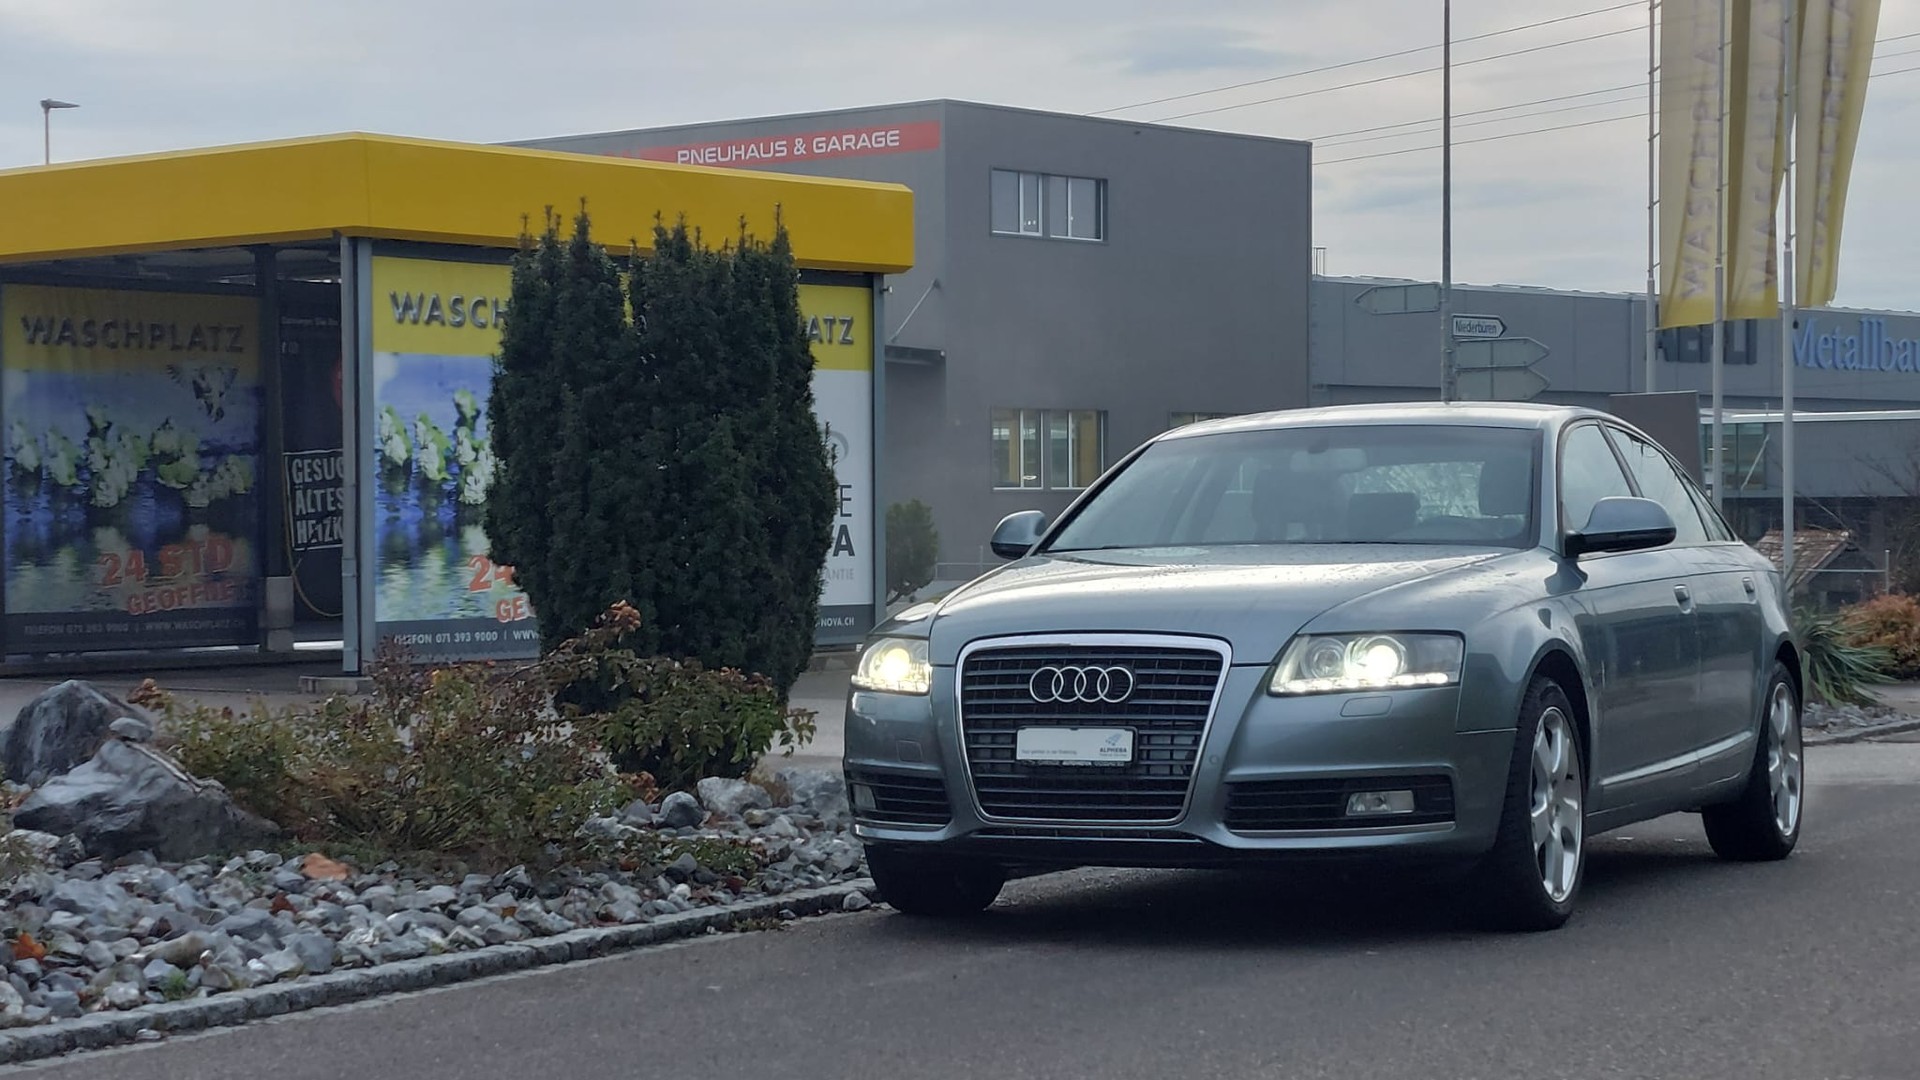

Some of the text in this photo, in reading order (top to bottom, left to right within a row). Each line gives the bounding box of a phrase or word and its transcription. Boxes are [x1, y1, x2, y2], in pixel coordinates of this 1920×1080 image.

[677, 129, 900, 164] PNEUHAUS & GARAGE
[21, 314, 244, 353] WASCHPLATZ
[806, 314, 854, 345] ATZ
[98, 535, 233, 586] 24 STD
[824, 568, 855, 580] ANTIE
[435, 631, 451, 644] 071
[454, 631, 471, 643] 393
[474, 630, 498, 642] 9000
